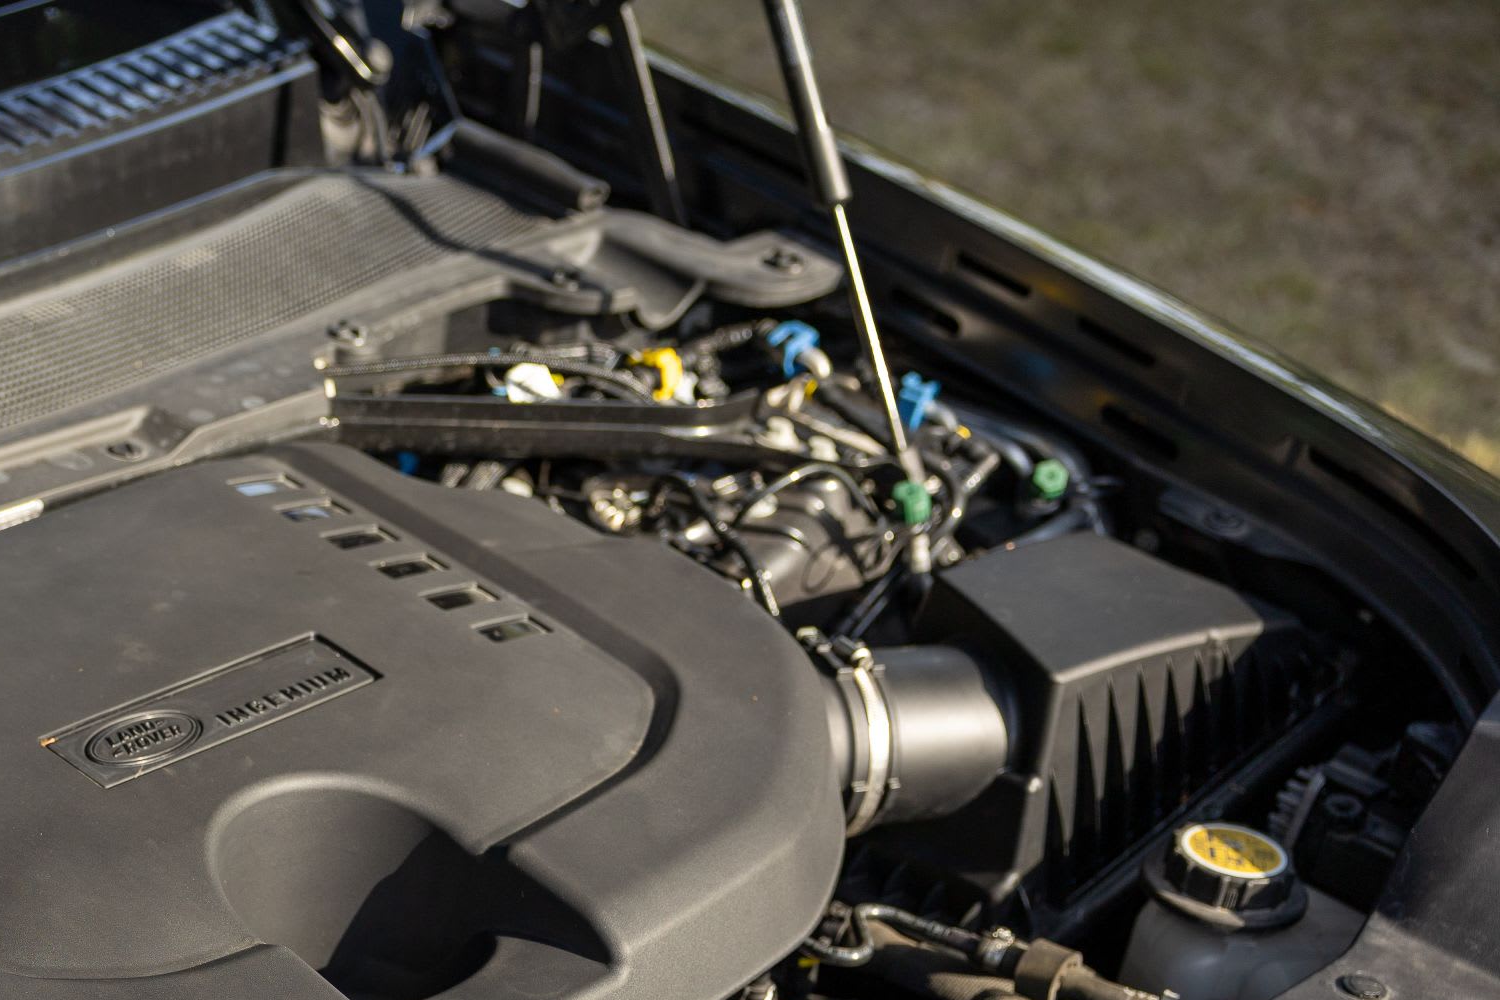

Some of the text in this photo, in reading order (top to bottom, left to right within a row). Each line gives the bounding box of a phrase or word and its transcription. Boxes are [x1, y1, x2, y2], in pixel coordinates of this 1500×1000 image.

[215, 666, 351, 727] INGENIUM
[105, 718, 161, 748] LAND
[120, 724, 185, 756] ROVER
